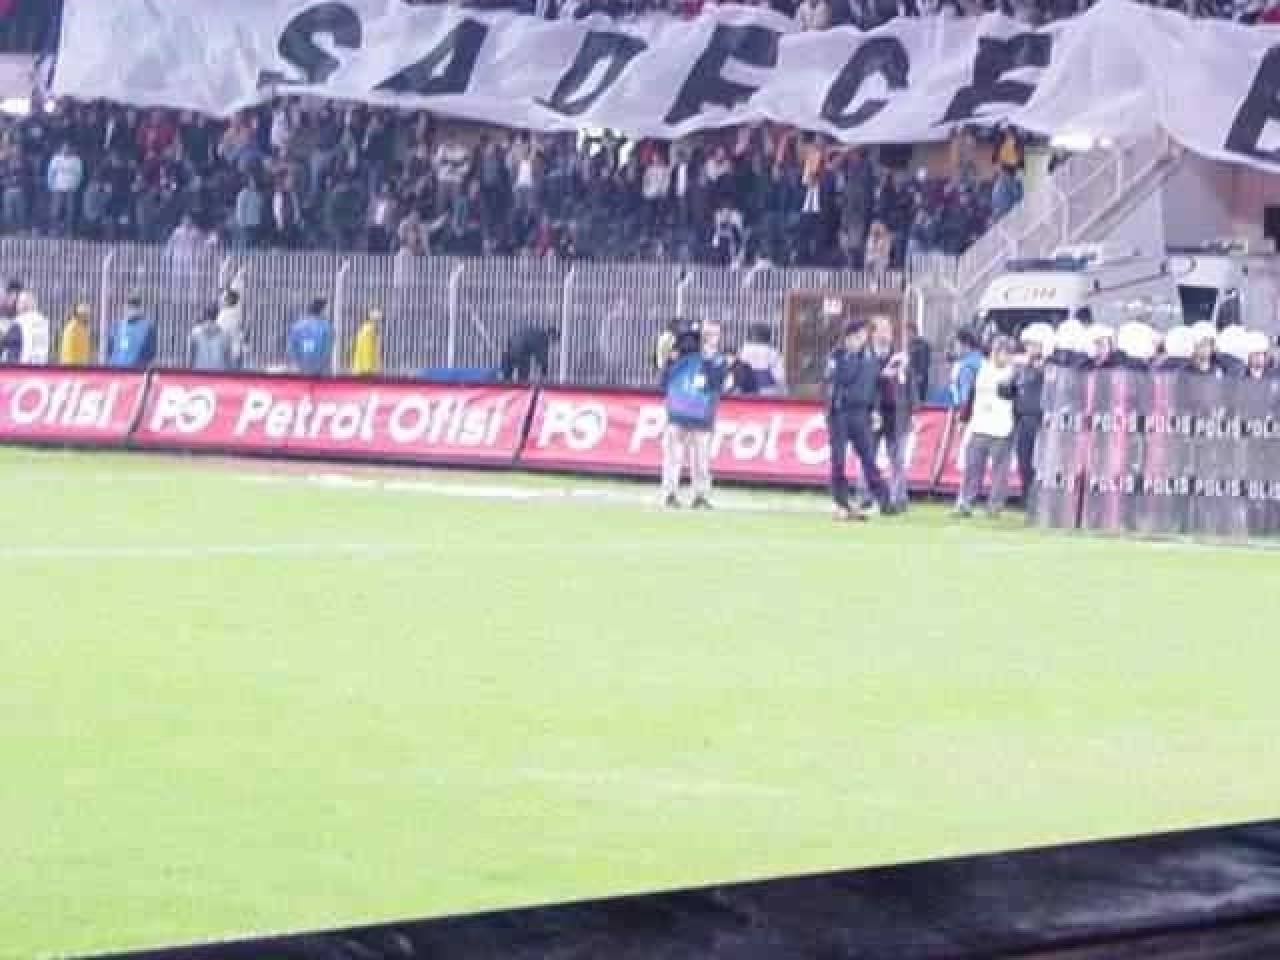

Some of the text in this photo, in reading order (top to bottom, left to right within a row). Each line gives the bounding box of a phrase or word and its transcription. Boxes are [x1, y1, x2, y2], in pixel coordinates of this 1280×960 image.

[256, 1, 1053, 127] SADECE
[234, 386, 384, 440] Petrol
[630, 408, 780, 464] Prol
